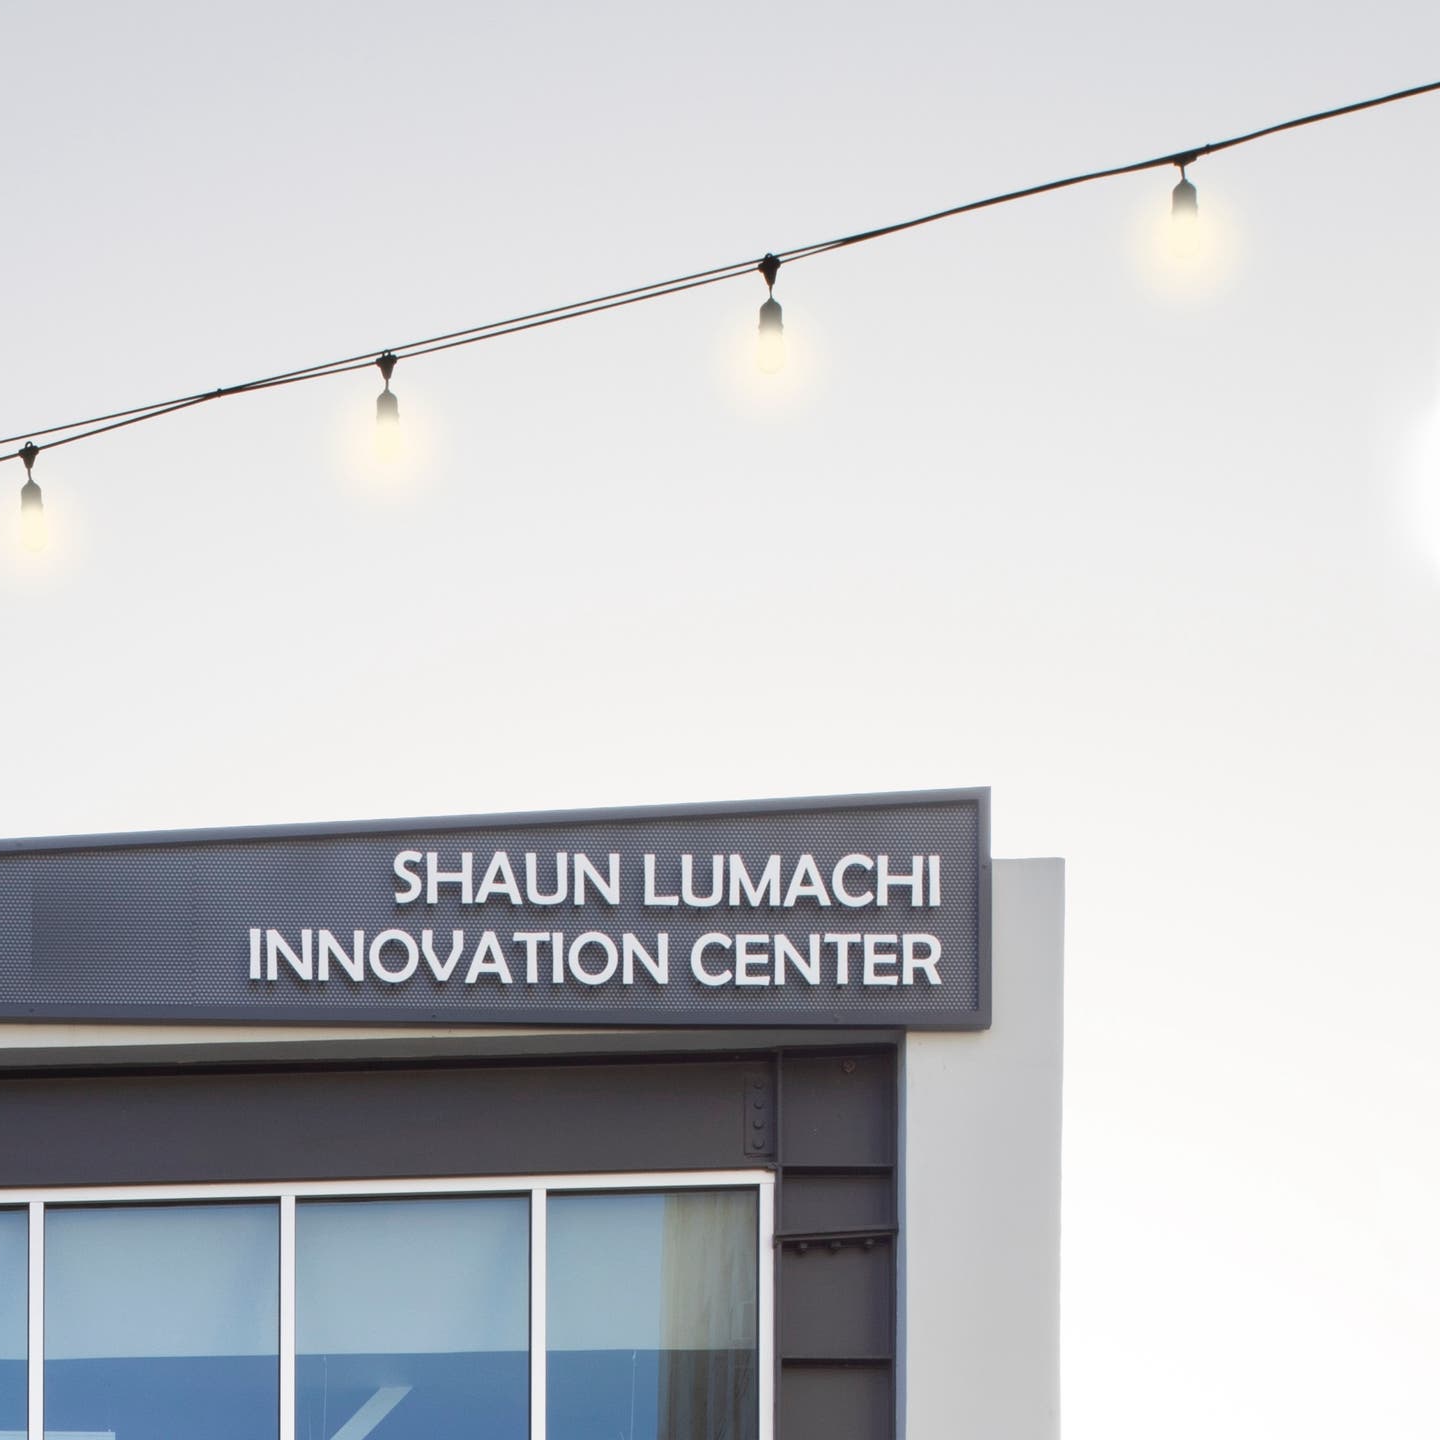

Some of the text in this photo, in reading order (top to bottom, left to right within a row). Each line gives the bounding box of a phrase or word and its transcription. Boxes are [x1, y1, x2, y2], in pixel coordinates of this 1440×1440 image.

[393, 850, 941, 907] SHAUN LUMACHI
[249, 928, 942, 986] INNOVATION CENTER
